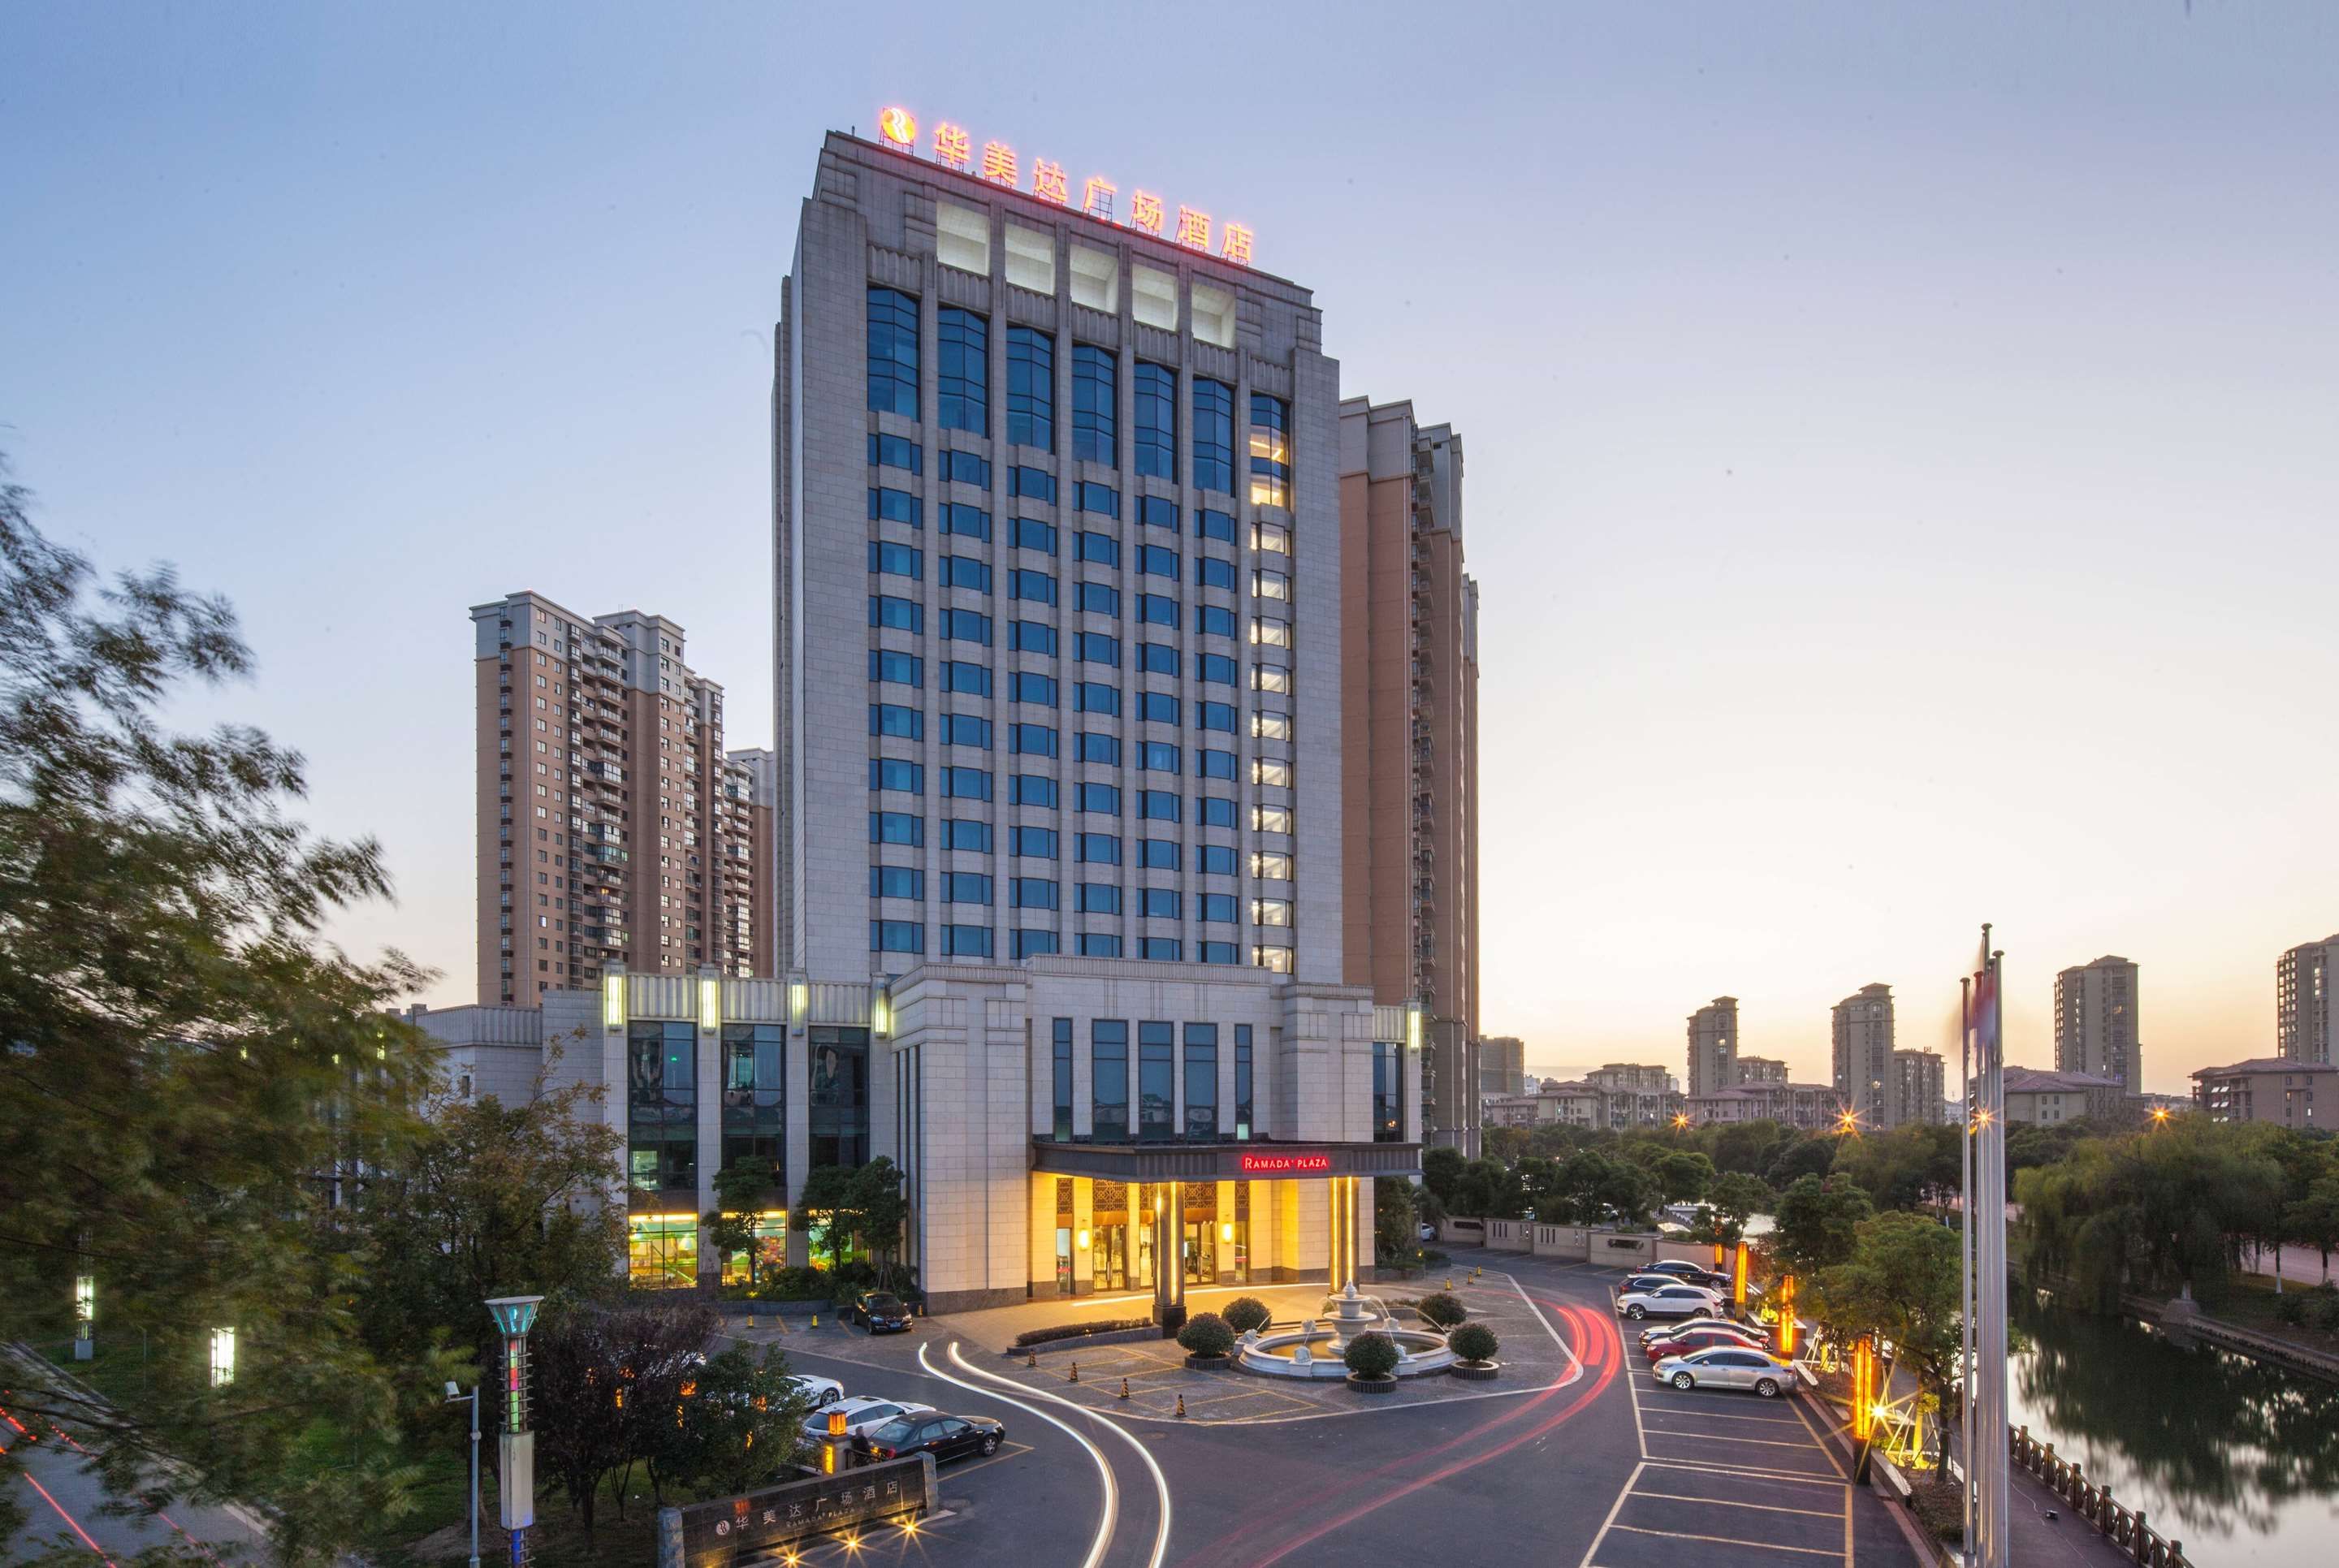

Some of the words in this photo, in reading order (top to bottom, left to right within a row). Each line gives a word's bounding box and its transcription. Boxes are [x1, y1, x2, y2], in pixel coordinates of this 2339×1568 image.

[934, 123, 1252, 262] 华美达广场酒店
[1245, 1157, 1290, 1169] RAMADA
[1297, 1158, 1328, 1168] PLAZA
[736, 1481, 897, 1529] 华美达广场酒店
